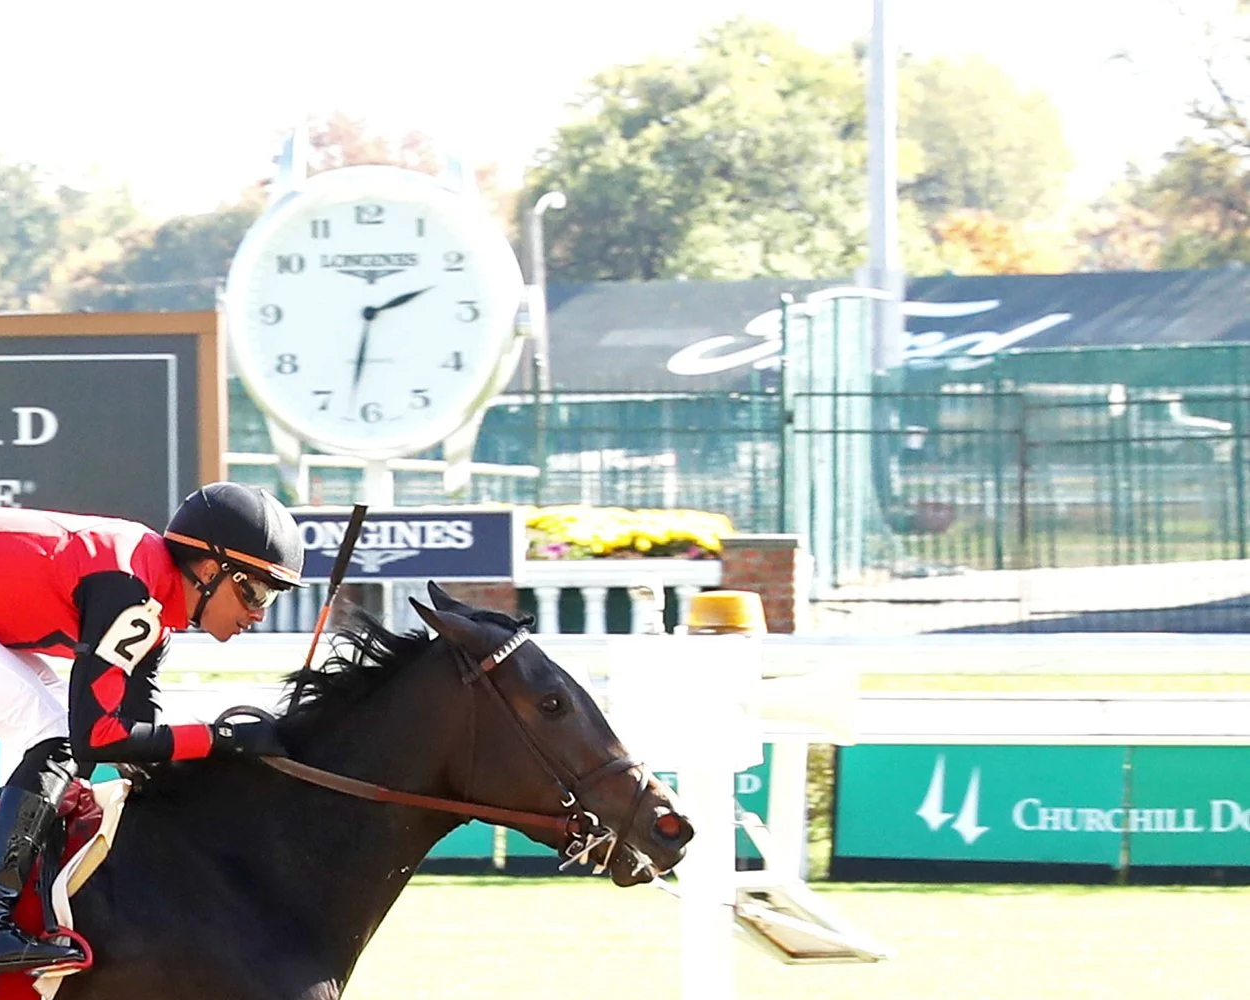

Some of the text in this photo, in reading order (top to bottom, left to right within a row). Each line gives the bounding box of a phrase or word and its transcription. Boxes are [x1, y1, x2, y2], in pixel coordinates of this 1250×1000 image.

[354, 204, 385, 224] 12
[310, 219, 330, 239] 11
[416, 218, 425, 237] 1
[275, 254, 305, 275] 10
[319, 253, 419, 268] LONGINES
[443, 251, 464, 272] 2
[259, 304, 283, 326] 9
[456, 301, 480, 323] 3
[275, 353, 299, 375] 8
[440, 352, 463, 372] 4
[312, 389, 333, 411] 7
[409, 388, 431, 409] 5
[359, 402, 383, 424] 6
[301, 520, 473, 549] ONGINES
[114, 617, 151, 662] 2
[1012, 798, 1204, 832] CHURCHILL
